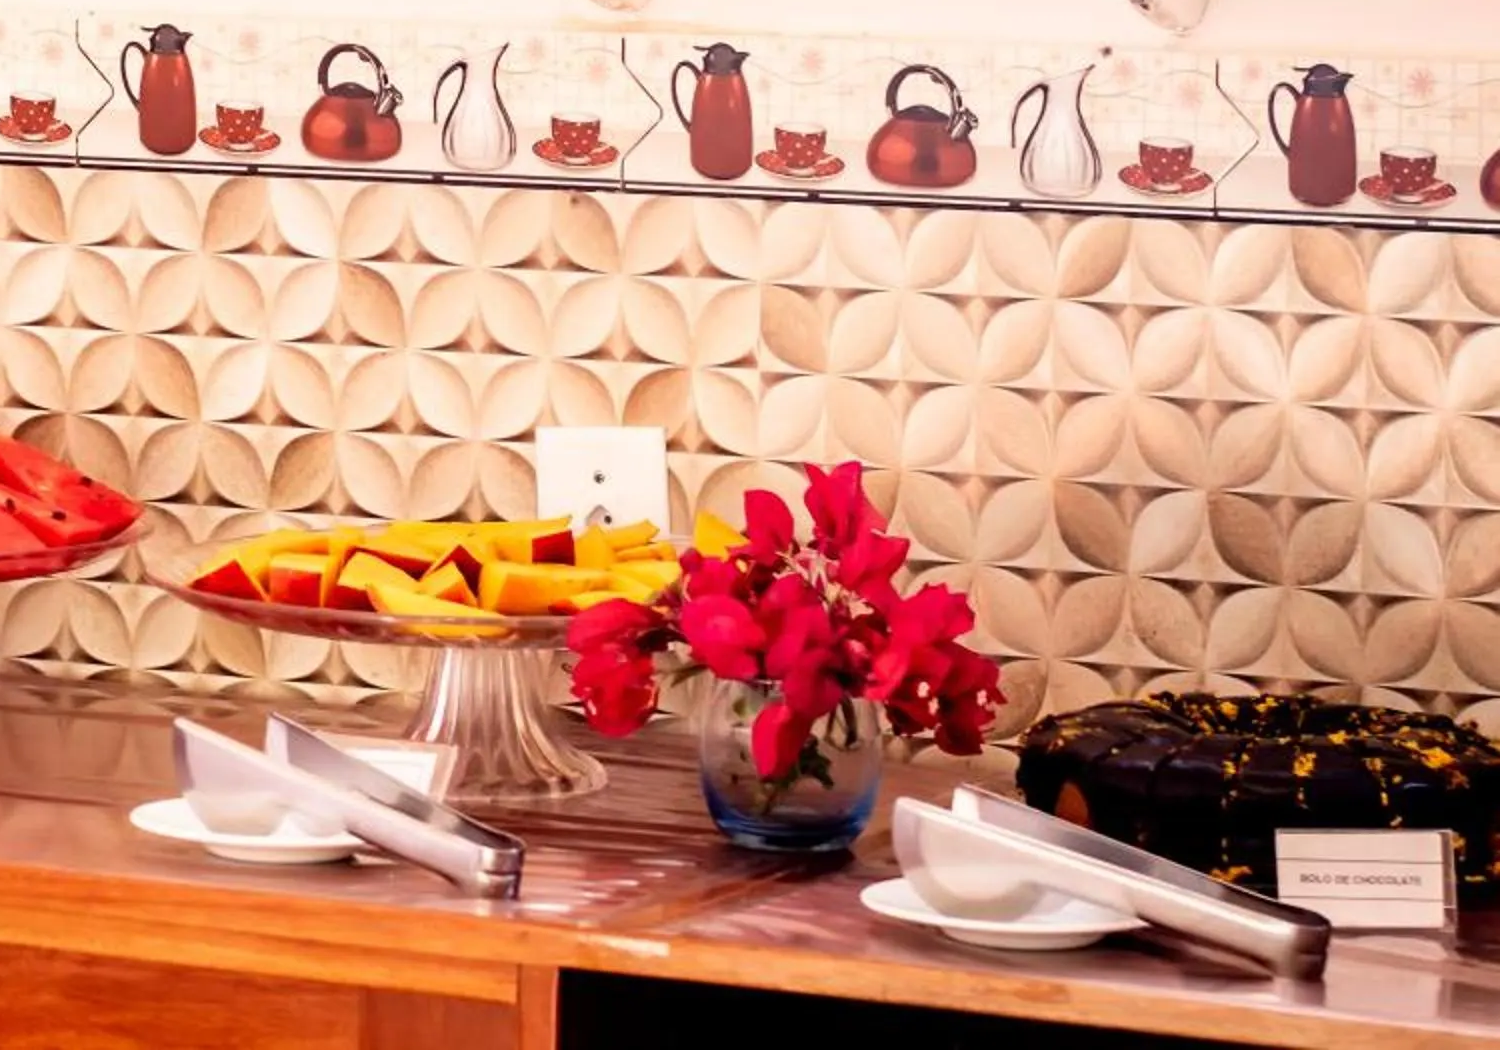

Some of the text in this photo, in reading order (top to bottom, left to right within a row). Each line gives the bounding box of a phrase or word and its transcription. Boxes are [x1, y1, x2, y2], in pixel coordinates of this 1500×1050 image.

[1299, 873, 1422, 887] BOLO DE CHOCOLATE
